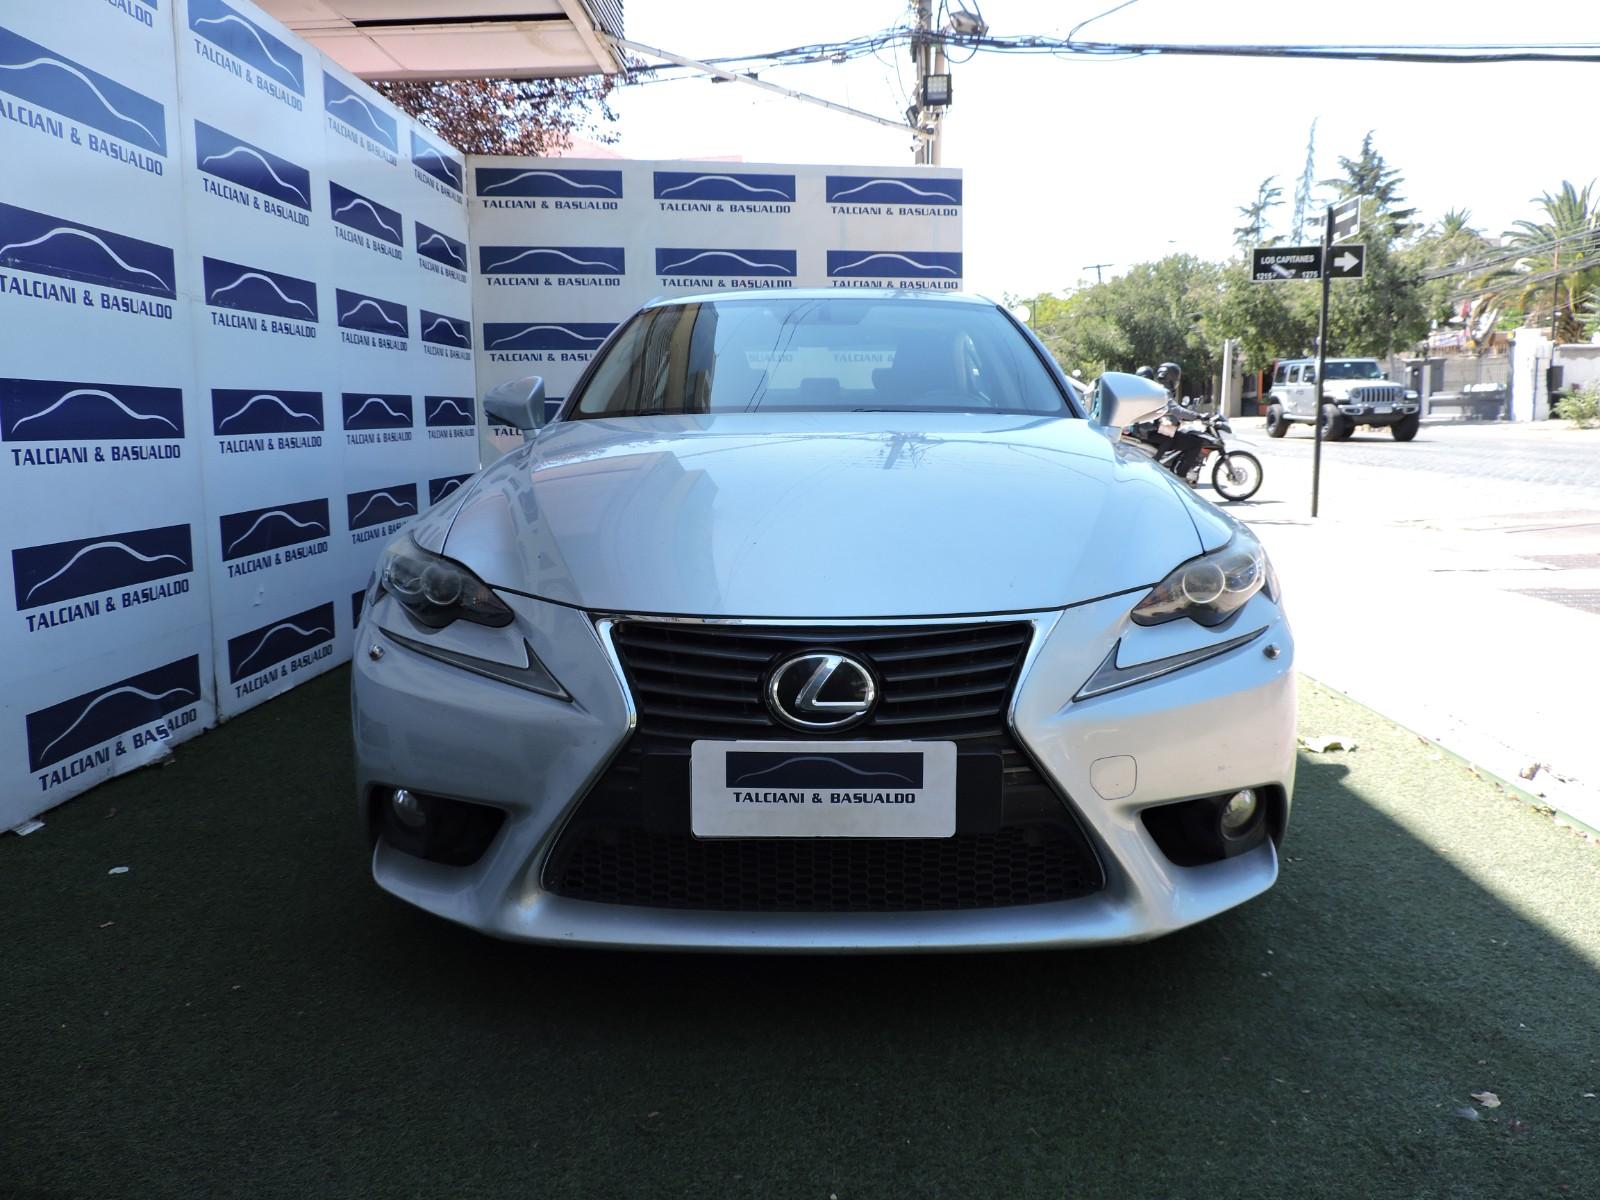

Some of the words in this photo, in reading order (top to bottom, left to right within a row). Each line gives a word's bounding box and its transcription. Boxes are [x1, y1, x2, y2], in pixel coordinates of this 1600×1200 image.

[193, 38, 243, 79] TALCIANI
[245, 69, 253, 83] &
[256, 75, 303, 112] BASUALDO
[70, 128, 82, 146] &
[88, 133, 164, 177] BASUALDO
[202, 177, 250, 207] TALCIANI
[253, 196, 261, 210] &
[264, 200, 310, 227] BASUALDO
[482, 199, 536, 210] TALCIANI
[541, 201, 550, 210] &
[555, 201, 619, 211] BASUALDO
[659, 202, 712, 213] TALCIANI
[716, 204, 725, 213] &
[729, 204, 791, 215] BASUALDO
[831, 205, 882, 216] TALCIANI
[886, 207, 895, 216] &
[898, 207, 959, 217] BASUALDO
[334, 226, 365, 248] TALCIANI
[372, 239, 403, 261] BASUALDO
[1260, 256, 1275, 265] LOS
[1276, 254, 1315, 264] CAPITANES
[486, 276, 540, 287] TALCIANI
[544, 278, 553, 287] &
[557, 277, 621, 287] BASUALDO
[662, 279, 713, 288] TALCIANI
[718, 279, 727, 288] &
[731, 279, 792, 289] BASUALDO
[832, 280, 882, 289] TALCIANI
[887, 280, 895, 289] &
[899, 281, 959, 290] BASUALDO
[0, 274, 76, 304] TALCIANI
[83, 290, 95, 307] &
[100, 293, 173, 320] BASUALDO
[210, 311, 258, 332] TALCIANI
[261, 320, 269, 333] &
[271, 321, 317, 339] BASUALDO
[341, 331, 371, 347] TALCIANI
[378, 338, 408, 352] BASUALDO
[490, 352, 543, 362] TALCIANI
[547, 353, 556, 362] &
[219, 439, 266, 455] TALCIANI
[267, 438, 275, 451] &
[277, 435, 323, 449] BASUALDO
[346, 434, 376, 446] TALCIANI
[382, 431, 413, 443] BASUALDO
[11, 447, 89, 467] TALCIANI
[94, 447, 106, 463] &
[111, 443, 182, 462] BASUALDO
[227, 555, 273, 579] TALCIANI
[274, 551, 283, 566] &
[284, 541, 329, 561] BASUALDO
[26, 599, 101, 633] TALCIANI
[105, 596, 117, 613] &
[121, 578, 190, 608] BASUALDO
[234, 669, 280, 699] TALCIANI
[281, 663, 289, 678] &
[289, 642, 334, 673] BASUALDO
[38, 747, 111, 792] TALCIANI
[114, 740, 128, 757] &
[732, 792, 805, 805] TALCIANI
[811, 793, 823, 805] &
[829, 793, 917, 805] BASUALDO
